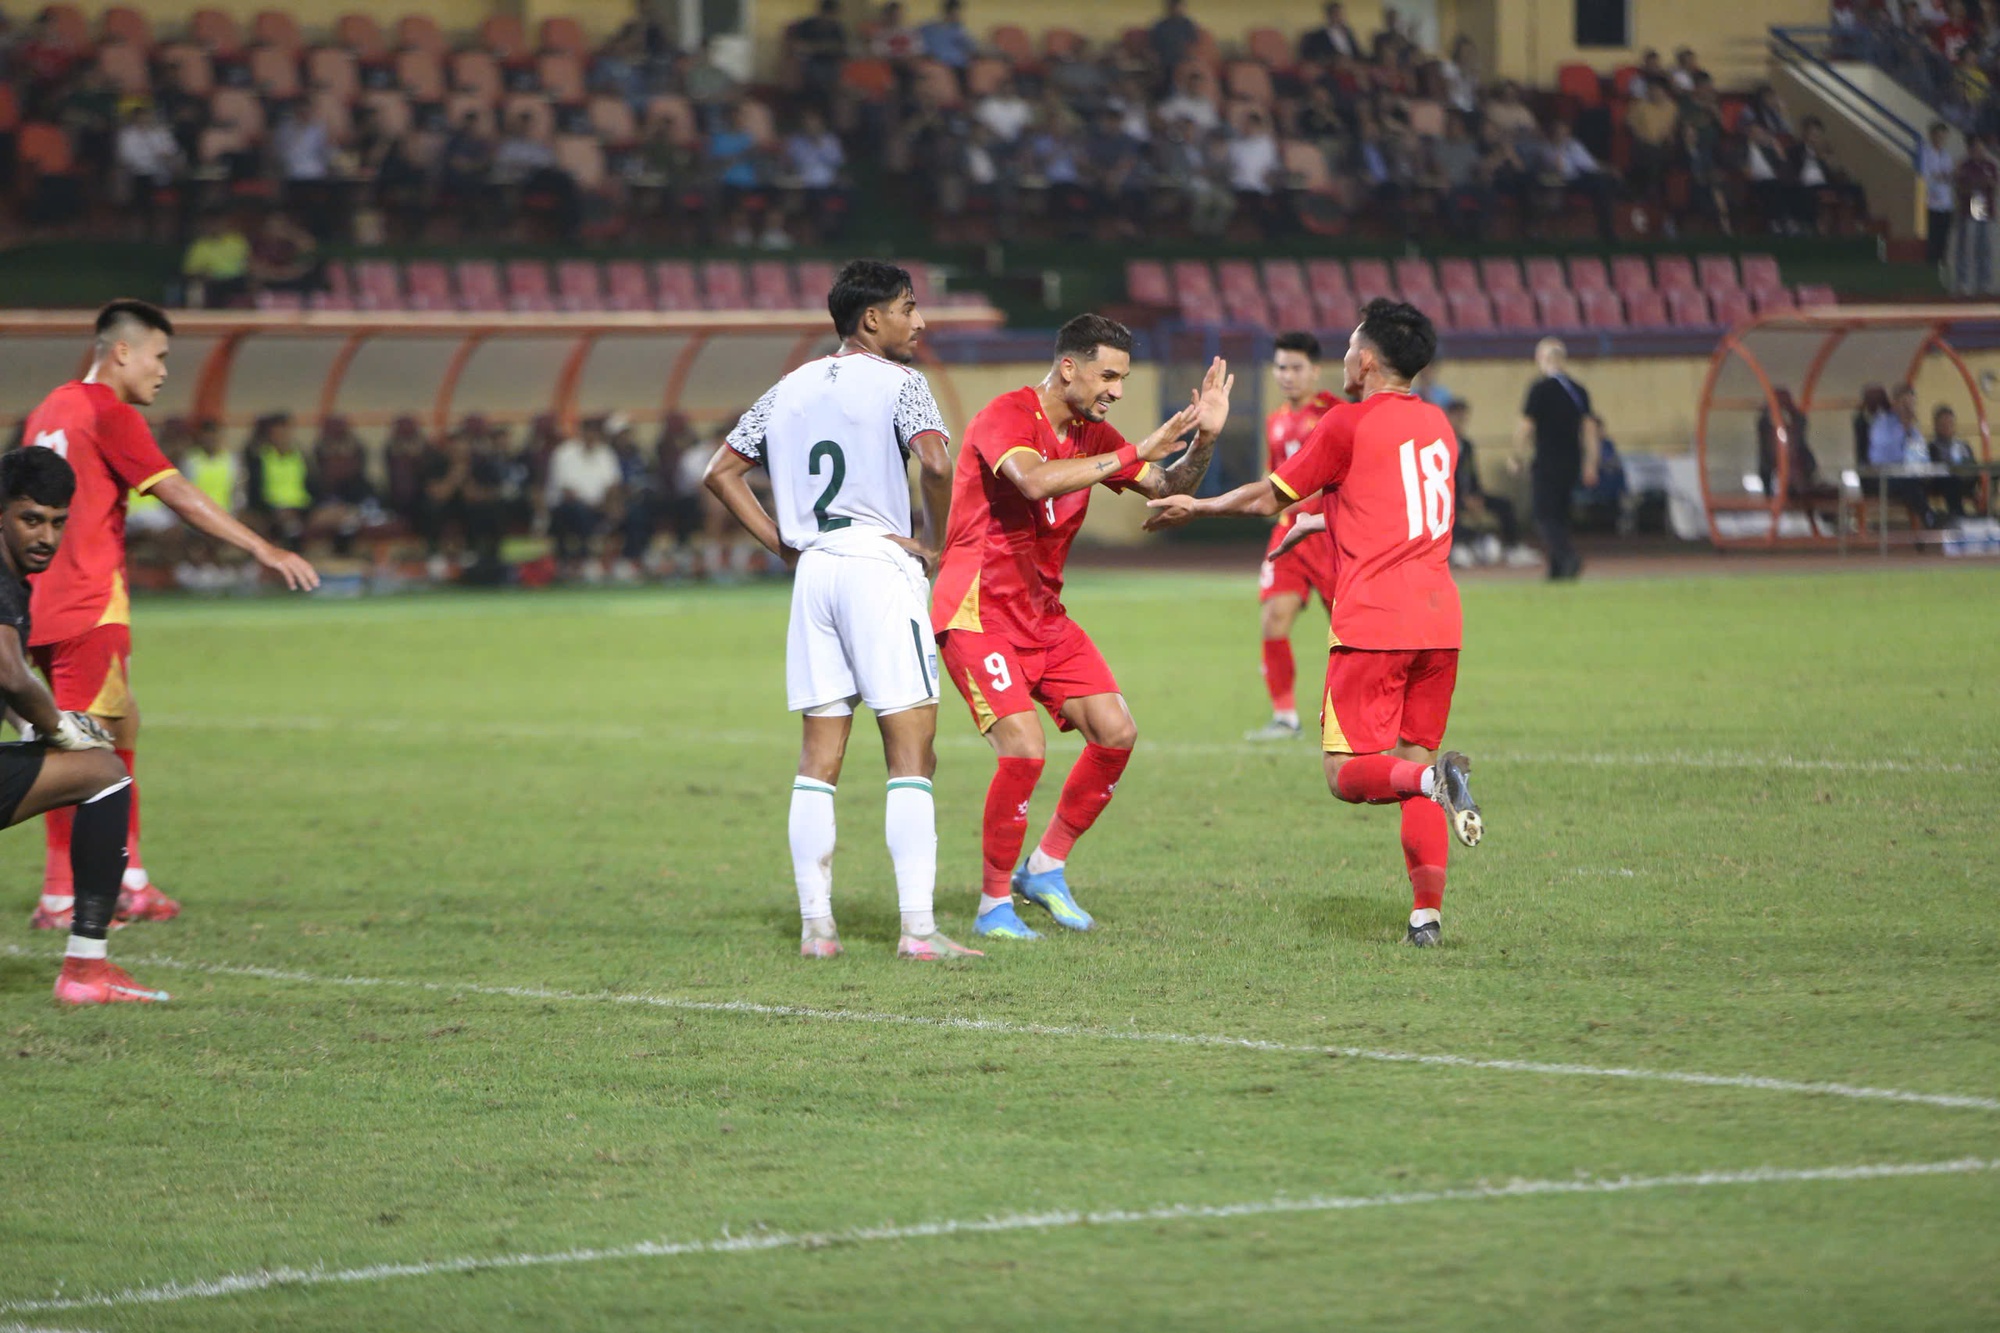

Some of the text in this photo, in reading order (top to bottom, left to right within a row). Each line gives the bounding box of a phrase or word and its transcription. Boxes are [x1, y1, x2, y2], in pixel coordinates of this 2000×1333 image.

[809, 440, 851, 533] 2
[1399, 438, 1451, 541] 18
[984, 652, 1012, 692] 9
